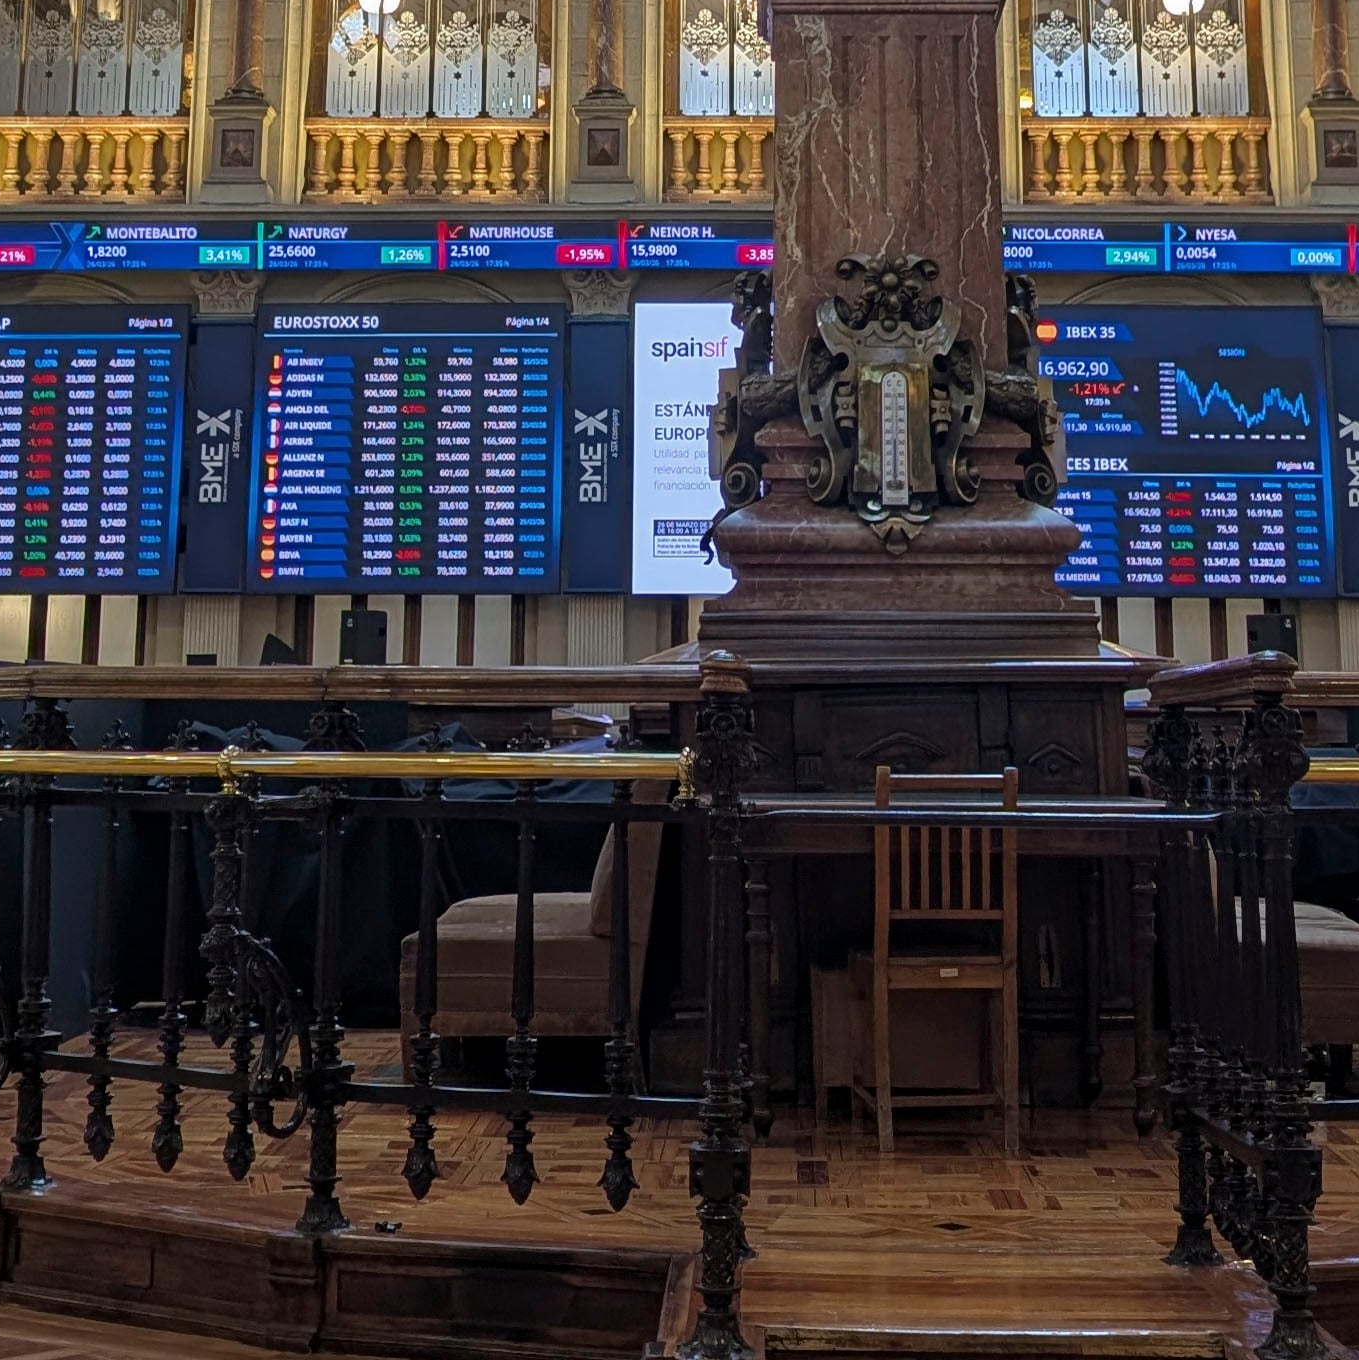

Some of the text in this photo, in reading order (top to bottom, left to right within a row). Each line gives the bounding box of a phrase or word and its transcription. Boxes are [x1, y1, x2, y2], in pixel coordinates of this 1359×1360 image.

[107, 228, 197, 240] MONTEBALITO
[288, 227, 348, 239] NATURGY
[469, 227, 554, 238] NATURHOUSE
[650, 227, 715, 238] NEINOR H.
[1012, 228, 1104, 240] NICOL.CORREA
[1196, 228, 1237, 241] NYESA
[87, 246, 127, 259] 1,8200
[206, 250, 242, 262] 3,41%
[268, 245, 315, 259] 25,6600
[388, 249, 424, 262] 1,26%
[450, 245, 490, 258] 2,5100
[564, 248, 604, 261] -1,95%
[632, 245, 677, 257] 15,9800
[745, 249, 774, 261] -3,85
[1113, 250, 1150, 263] 2,94%
[1176, 247, 1217, 260] 0,0054
[1297, 252, 1335, 265] 0,00%
[129, 319, 173, 330] Página 1/3
[274, 316, 379, 329] EUROSTOXX 50
[506, 317, 550, 328] Página 1/4
[1066, 326, 1116, 338] IBEX 35
[652, 336, 728, 362] spainsif
[1039, 361, 1108, 378] 16.962,90
[286, 374, 315, 382] ADIDAS
[1069, 383, 1109, 396] -1,21%
[1085, 398, 1103, 406] 17:35
[285, 406, 329, 414] AHOLD DEL
[300, 422, 332, 431] LIQUIDE
[1094, 423, 1132, 432] 16.919,80
[283, 437, 313, 445] AIRBUS
[283, 454, 316, 462] ALLIANZ
[654, 449, 689, 458] Utilidad
[654, 465, 701, 474] relevancia
[1094, 458, 1128, 471] IBEX
[1277, 462, 1315, 472] Página 1/2
[199, 443, 223, 503] BME
[282, 470, 314, 478] ARGENX
[579, 443, 601, 502] BME
[305, 486, 341, 494] HOLDING
[654, 480, 710, 490] financiación
[281, 502, 297, 510] AXA
[1066, 573, 1100, 582] MEDIUM
